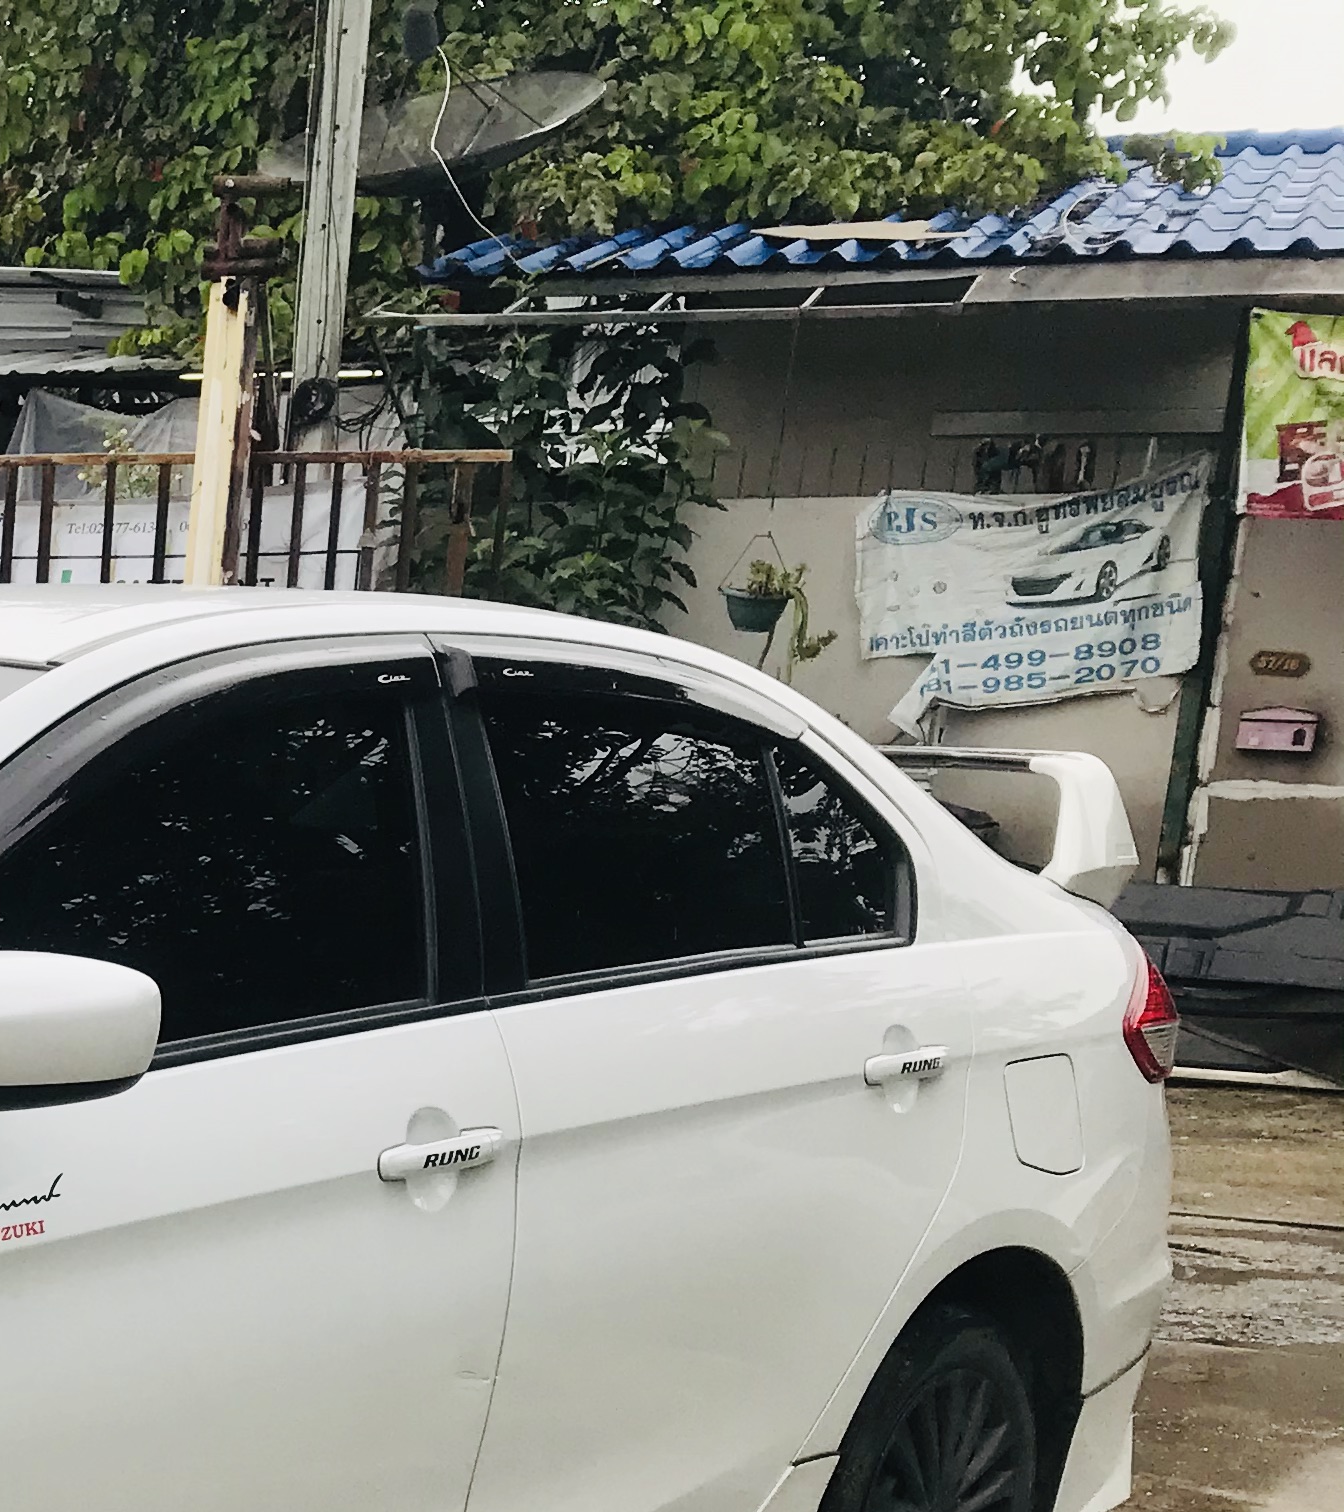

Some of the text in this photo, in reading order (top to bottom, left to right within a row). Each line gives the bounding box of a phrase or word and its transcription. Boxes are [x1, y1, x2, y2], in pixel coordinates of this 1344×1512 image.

[886, 507, 938, 534] PJS
[900, 1056, 941, 1075] RUNG
[422, 1145, 481, 1169] RUNG
